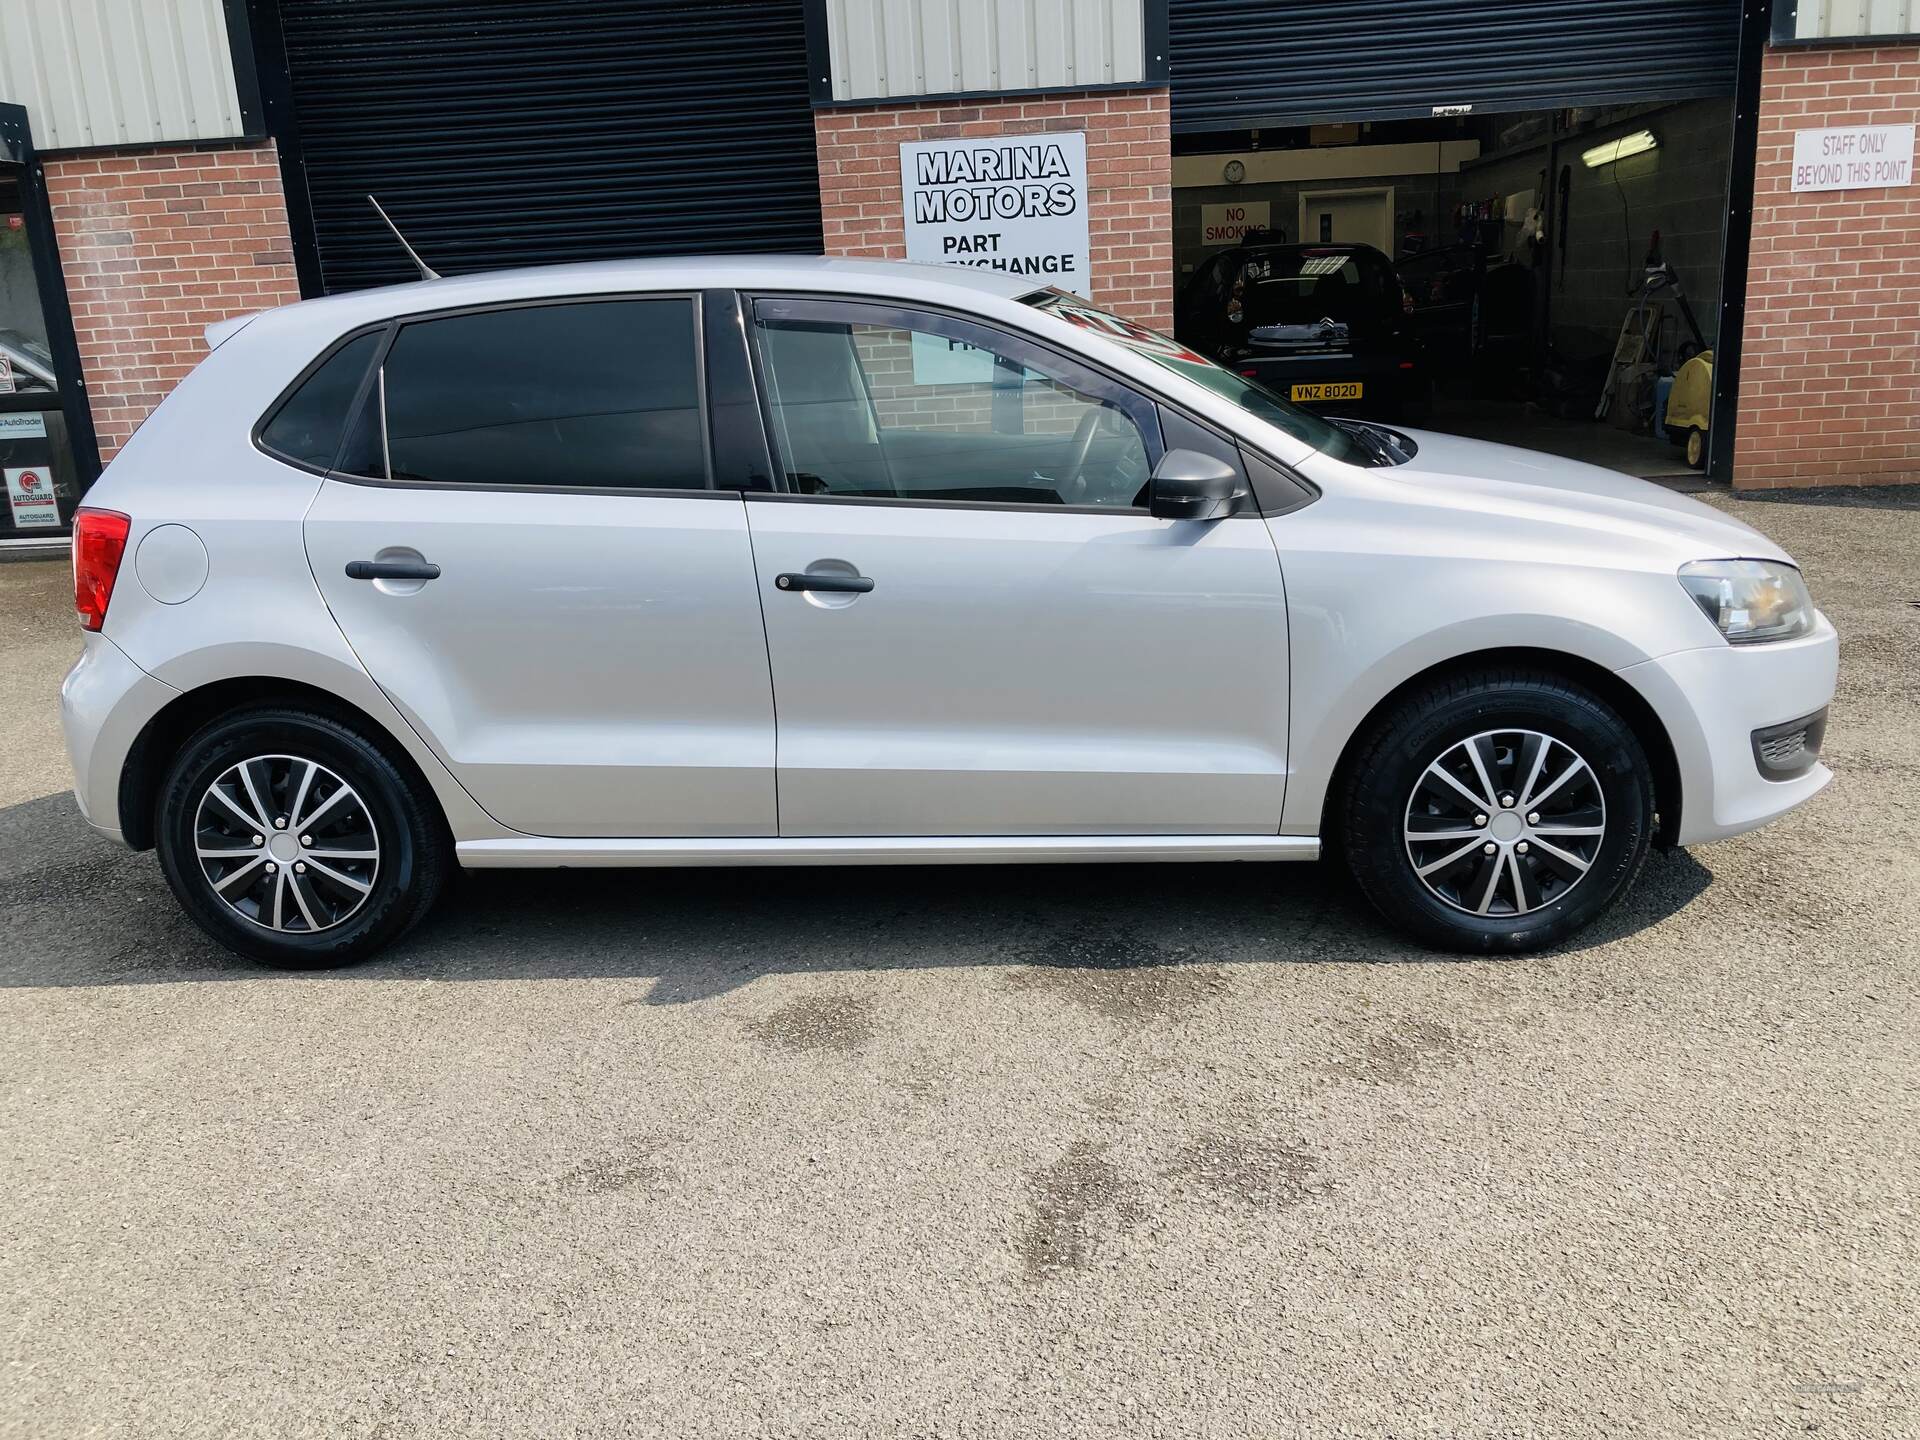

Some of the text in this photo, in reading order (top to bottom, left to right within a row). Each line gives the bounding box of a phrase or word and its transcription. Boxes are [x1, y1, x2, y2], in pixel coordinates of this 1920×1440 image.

[1822, 133, 1888, 156] STAFF ONLY
[916, 144, 1071, 186] MARINA
[1797, 160, 1908, 186] BEYOND THIS POINT
[914, 183, 1076, 224] MOTORS
[1226, 207, 1246, 221] NO
[943, 233, 1002, 254] PART
[944, 254, 1075, 275] HANGE
[1297, 384, 1357, 399] VNZ 8020
[12, 493, 53, 502] AUTOGUARD
